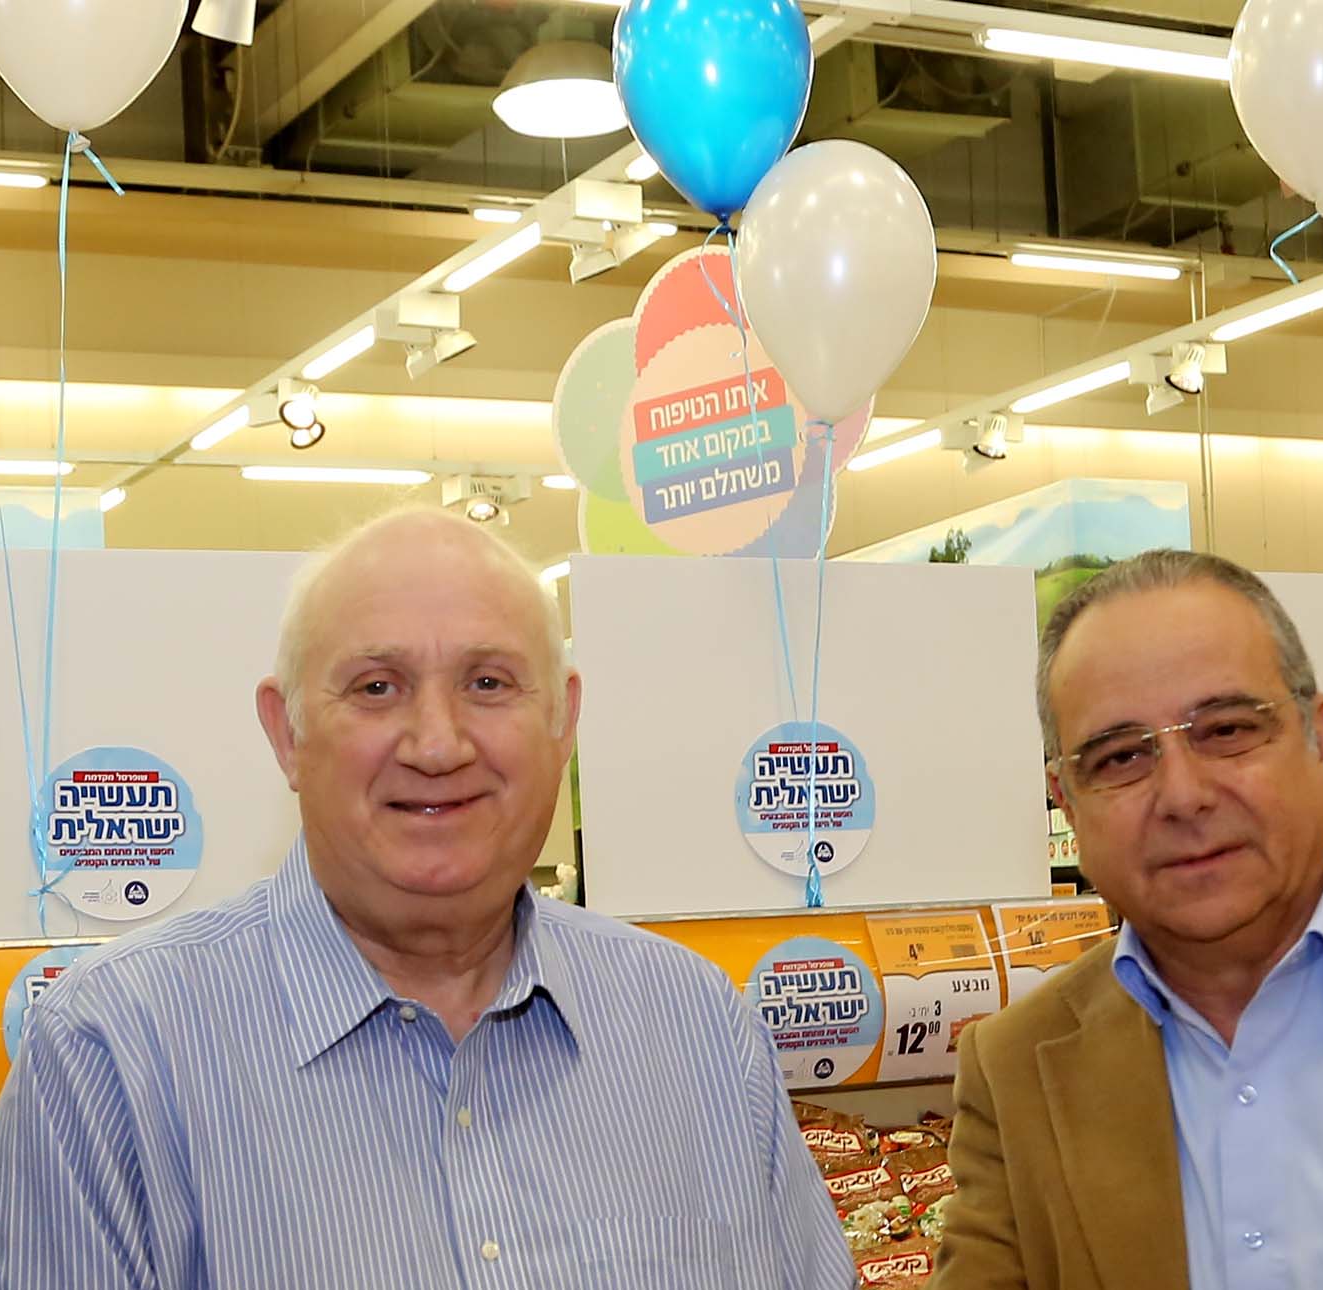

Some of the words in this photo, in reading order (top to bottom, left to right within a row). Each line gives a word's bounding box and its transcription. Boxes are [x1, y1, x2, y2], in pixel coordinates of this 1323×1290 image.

[724, 379, 769, 411] אותו
[649, 392, 721, 431] הטיפוח
[656, 441, 701, 468] אחד
[705, 423, 773, 461] במקום
[700, 462, 782, 503] משתלם
[656, 484, 697, 511] יותר
[60, 786, 172, 807] תעשייה
[52, 810, 180, 840] ישראלית
[764, 971, 857, 996] תעשייה
[952, 977, 991, 993] מבצע
[934, 1000, 942, 1017] 3
[896, 1022, 928, 1056] 12
